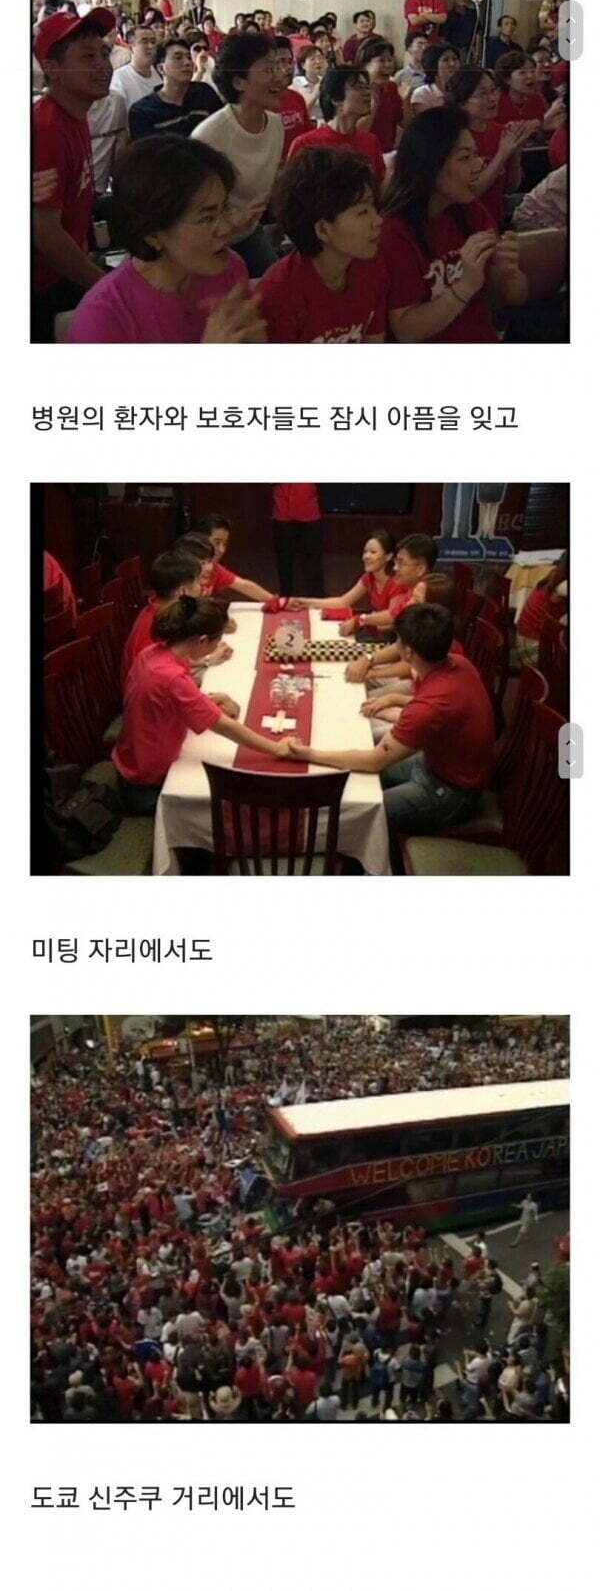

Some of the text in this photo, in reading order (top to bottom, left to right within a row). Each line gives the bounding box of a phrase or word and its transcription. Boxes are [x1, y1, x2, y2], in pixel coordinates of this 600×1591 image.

[285, 633, 295, 648] 2
[350, 1153, 460, 1187] WELCOME
[464, 1143, 533, 1171] KOREA
